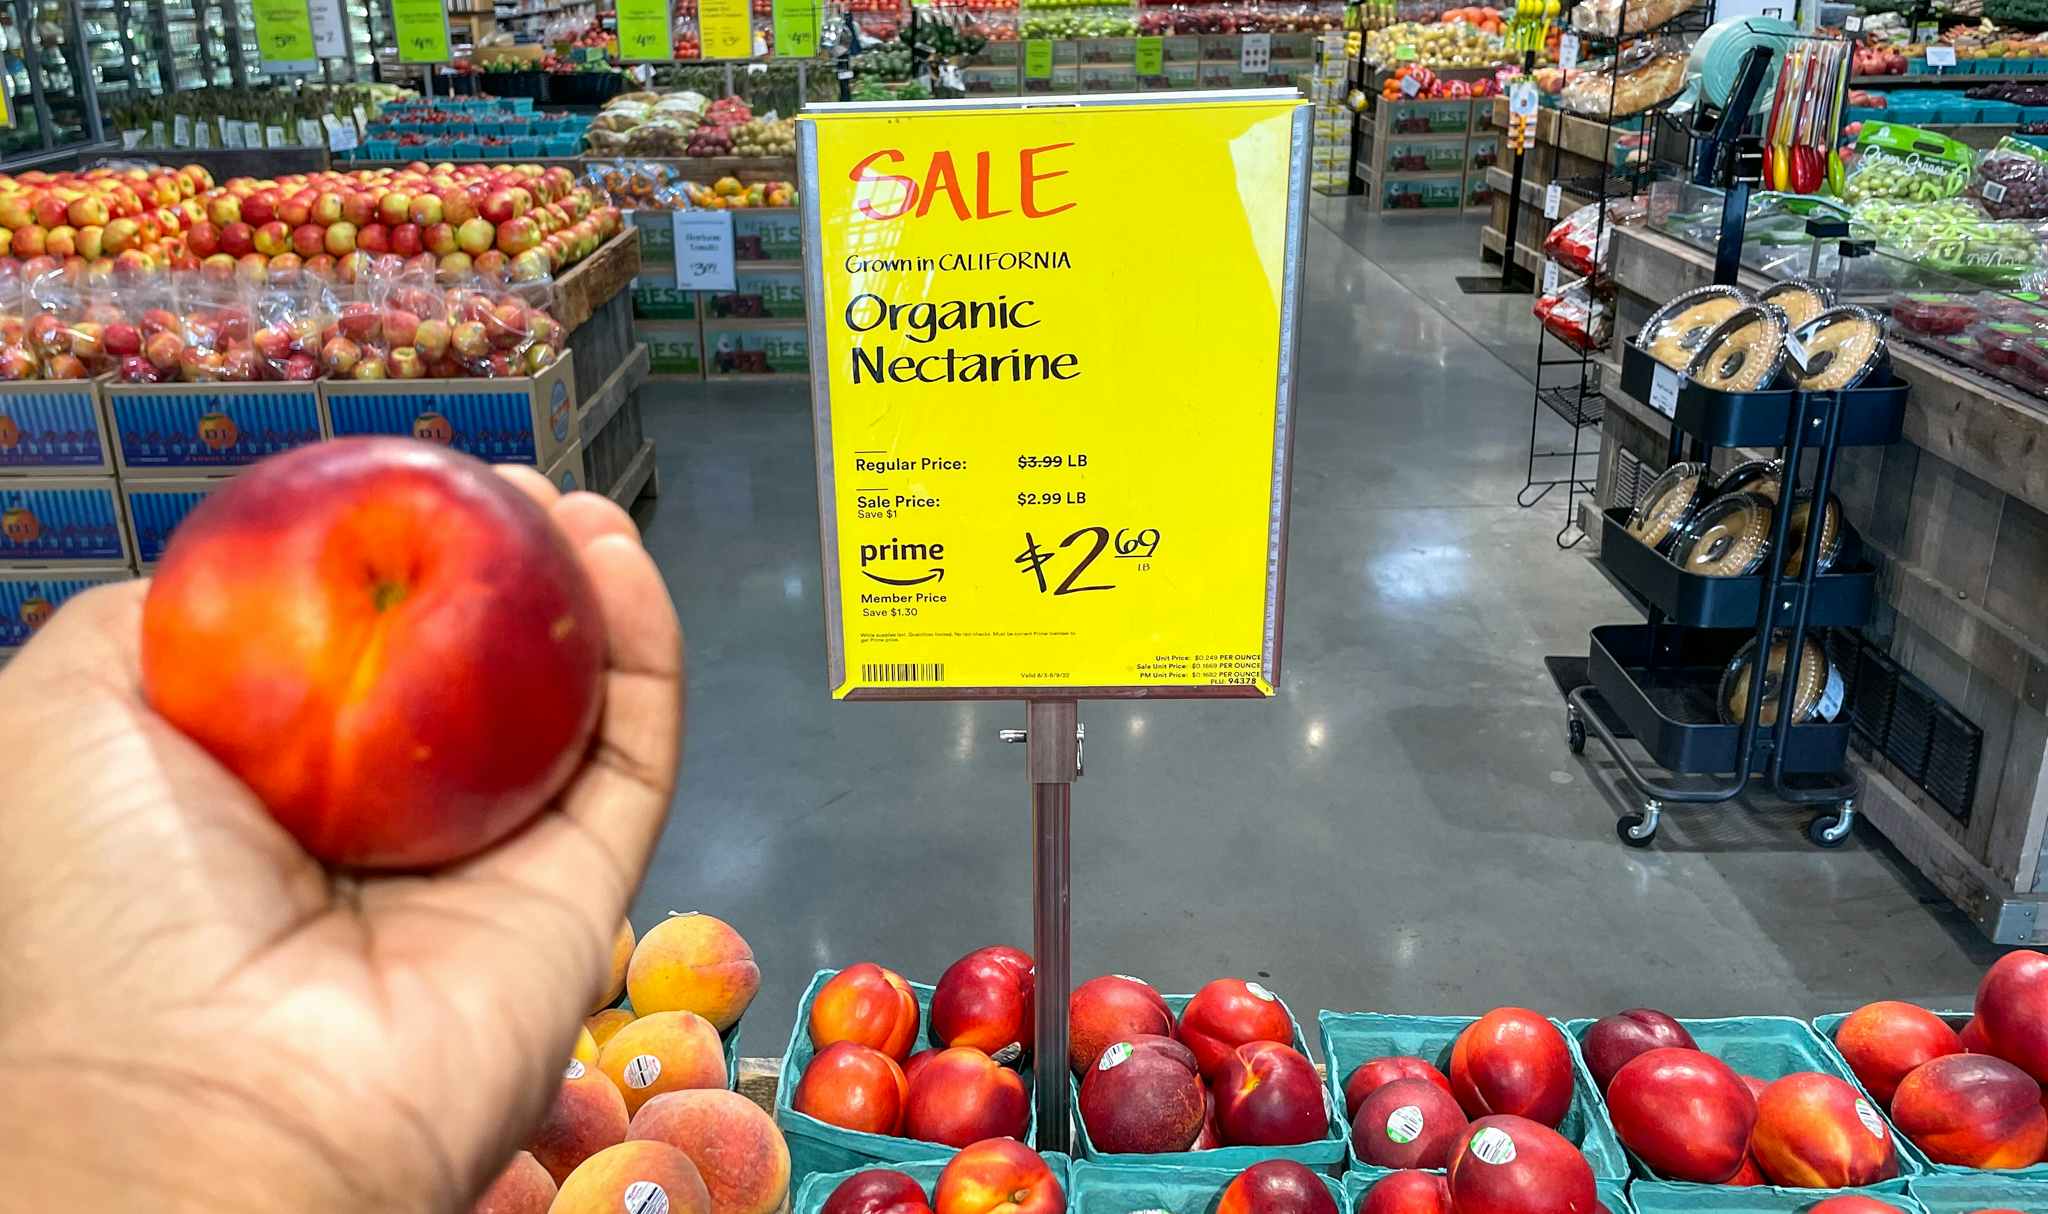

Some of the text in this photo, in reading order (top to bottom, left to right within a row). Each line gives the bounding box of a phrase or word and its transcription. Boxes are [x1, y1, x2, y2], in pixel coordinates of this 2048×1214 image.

[849, 142, 1078, 222] SALE
[759, 224, 800, 240] BES
[845, 251, 1072, 274] Grown in CALIFORNIA
[761, 285, 801, 301] BES
[845, 293, 1042, 343] Organic
[764, 341, 806, 357] BES
[852, 346, 1081, 384] Nectarine
[856, 454, 1087, 474] Regular Price: $3.99 LB
[857, 492, 1086, 508] Sale Price: $2.99 LB
[857, 509, 897, 519] Save $1
[860, 537, 944, 566] prime
[860, 592, 947, 603] Member Price
[862, 607, 918, 617] Save $1.30
